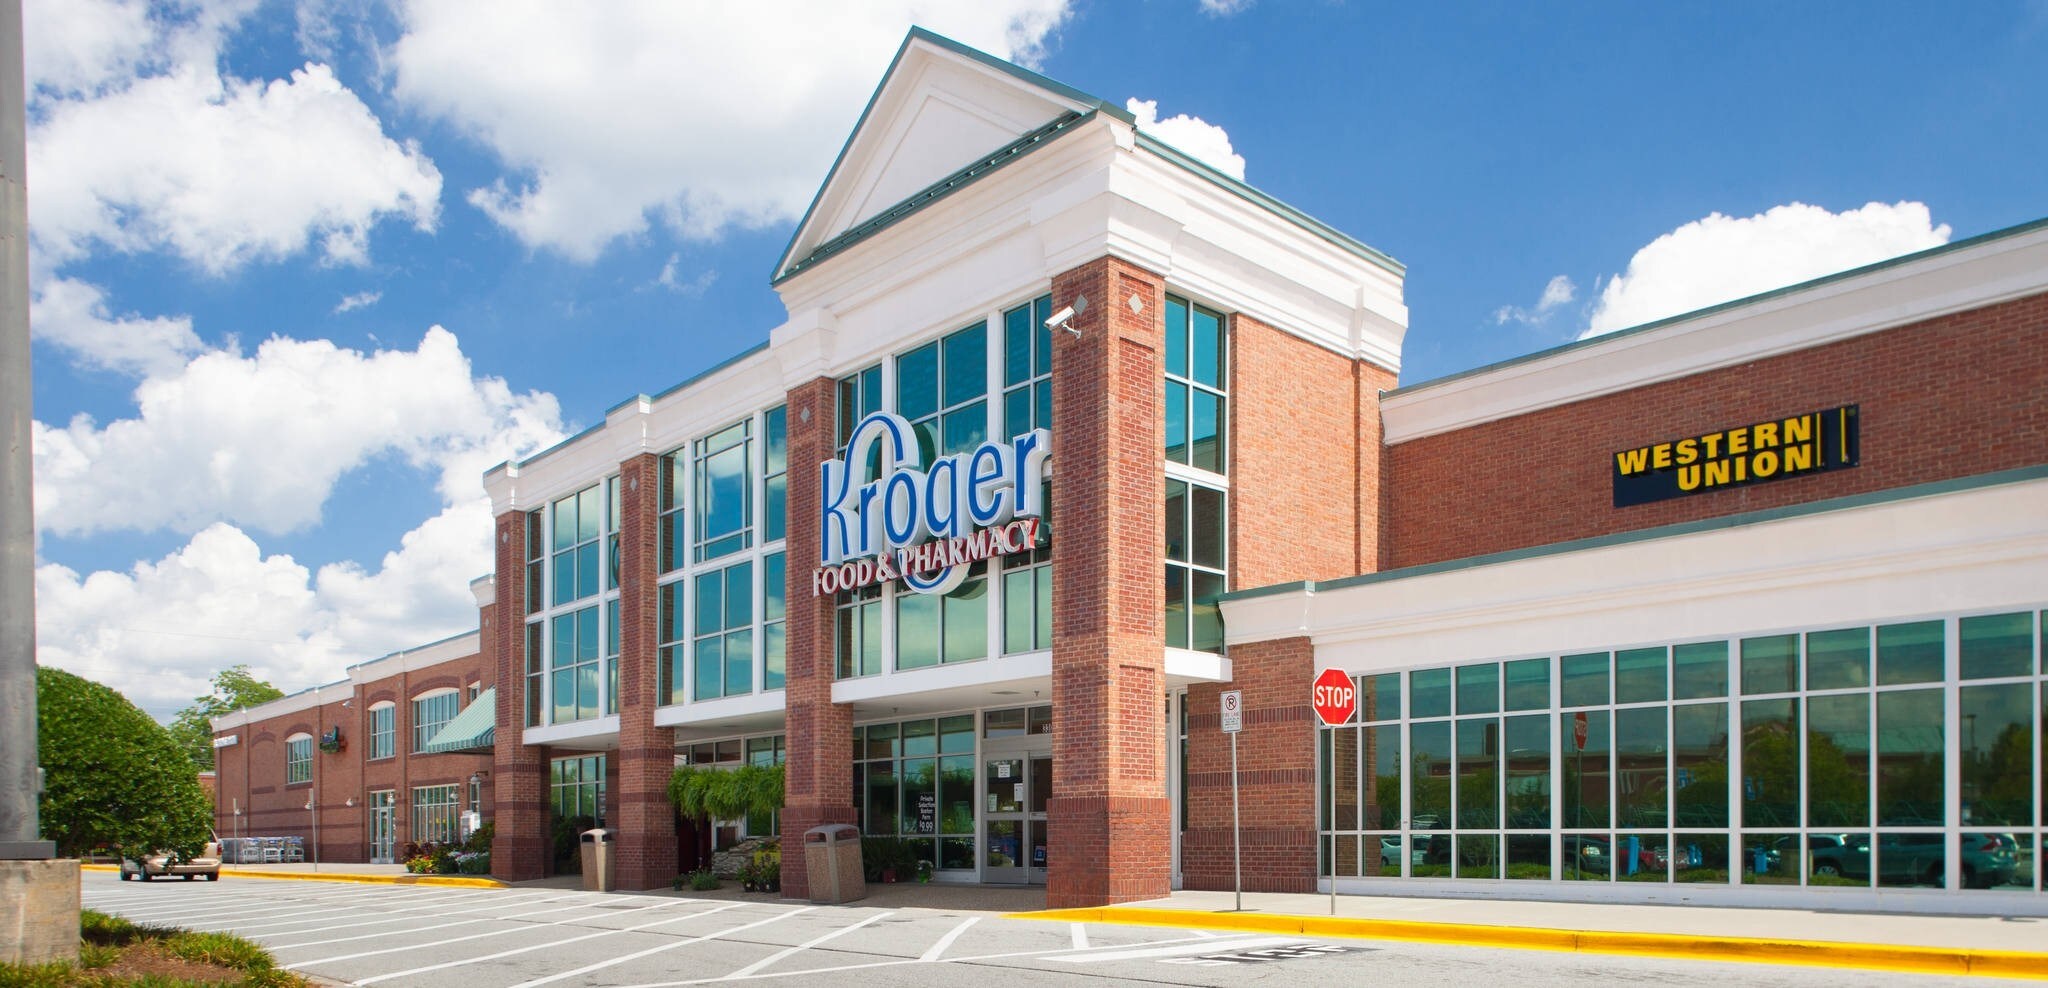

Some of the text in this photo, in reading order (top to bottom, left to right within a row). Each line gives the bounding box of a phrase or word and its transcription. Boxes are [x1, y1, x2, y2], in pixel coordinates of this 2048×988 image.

[1616, 414, 1811, 476] WESTERN
[1677, 443, 1811, 491] UNION
[820, 412, 1049, 593] Kroger
[812, 518, 1040, 598] FOOD & PHARMACY
[1315, 685, 1353, 709] STOP
